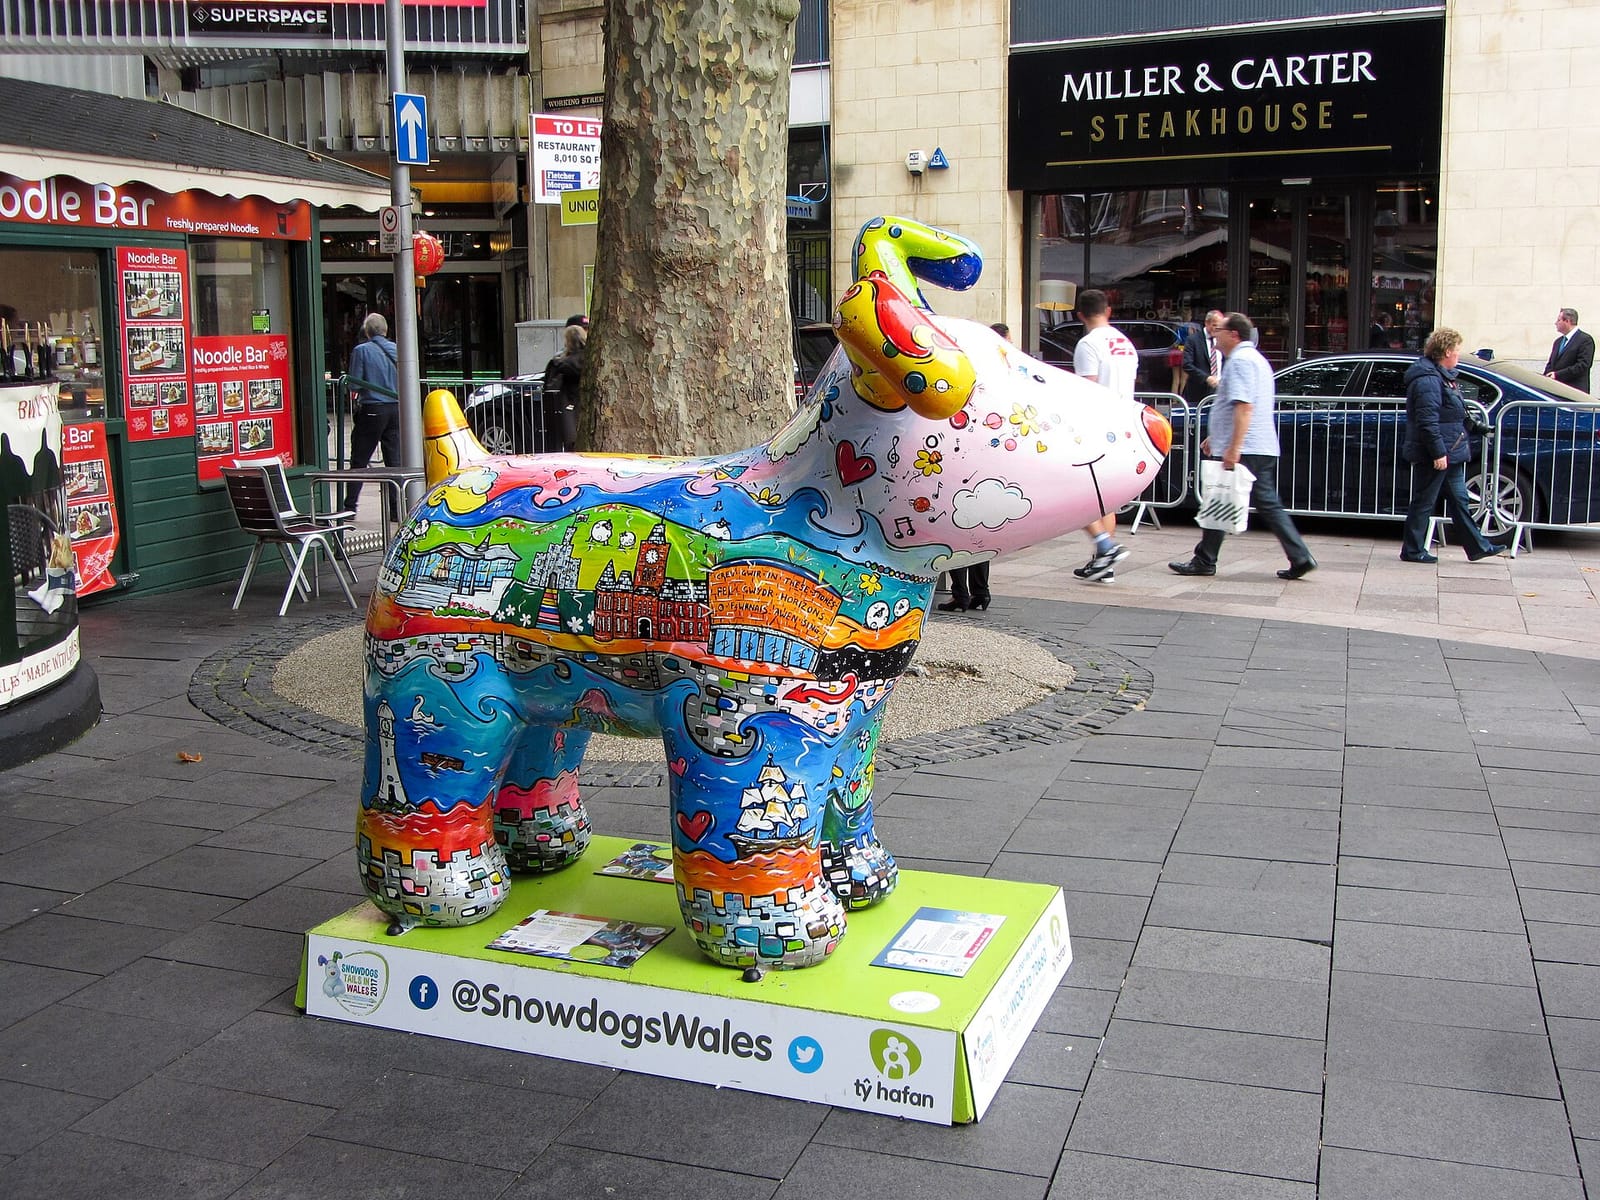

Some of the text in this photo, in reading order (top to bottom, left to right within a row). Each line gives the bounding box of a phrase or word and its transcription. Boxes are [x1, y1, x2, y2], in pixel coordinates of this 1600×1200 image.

[210, 8, 328, 24] SUPERSPACE
[1061, 51, 1377, 103] MILLER & CARTER
[581, 95, 605, 105] STREE
[553, 121, 602, 136] TO LET
[1090, 101, 1333, 142] STEAKHOUSE
[537, 141, 596, 152] RESTAURANT
[554, 154, 578, 164] 8,010
[580, 155, 592, 164] SQ
[547, 171, 576, 181] Fletcher
[547, 181, 574, 190] Morgan
[0, 178, 155, 226] odle Bar
[568, 199, 600, 213] UNIQ
[195, 221, 229, 234] prepared
[230, 223, 260, 235] Noodles
[127, 252, 178, 265] Noodle Bar
[193, 346, 268, 366] Noodle Bar
[69, 427, 94, 444] Bar
[767, 571, 779, 580] IN
[785, 577, 809, 593] THESE
[780, 592, 825, 621] HORIZONS
[341, 963, 379, 979] SNOWDOGS
[344, 974, 362, 985] TAILS
[370, 978, 378, 997] 2017
[346, 984, 370, 996] WALES
[451, 979, 773, 1062] @SnowdogsWales
[876, 1081, 934, 1109] hafan
